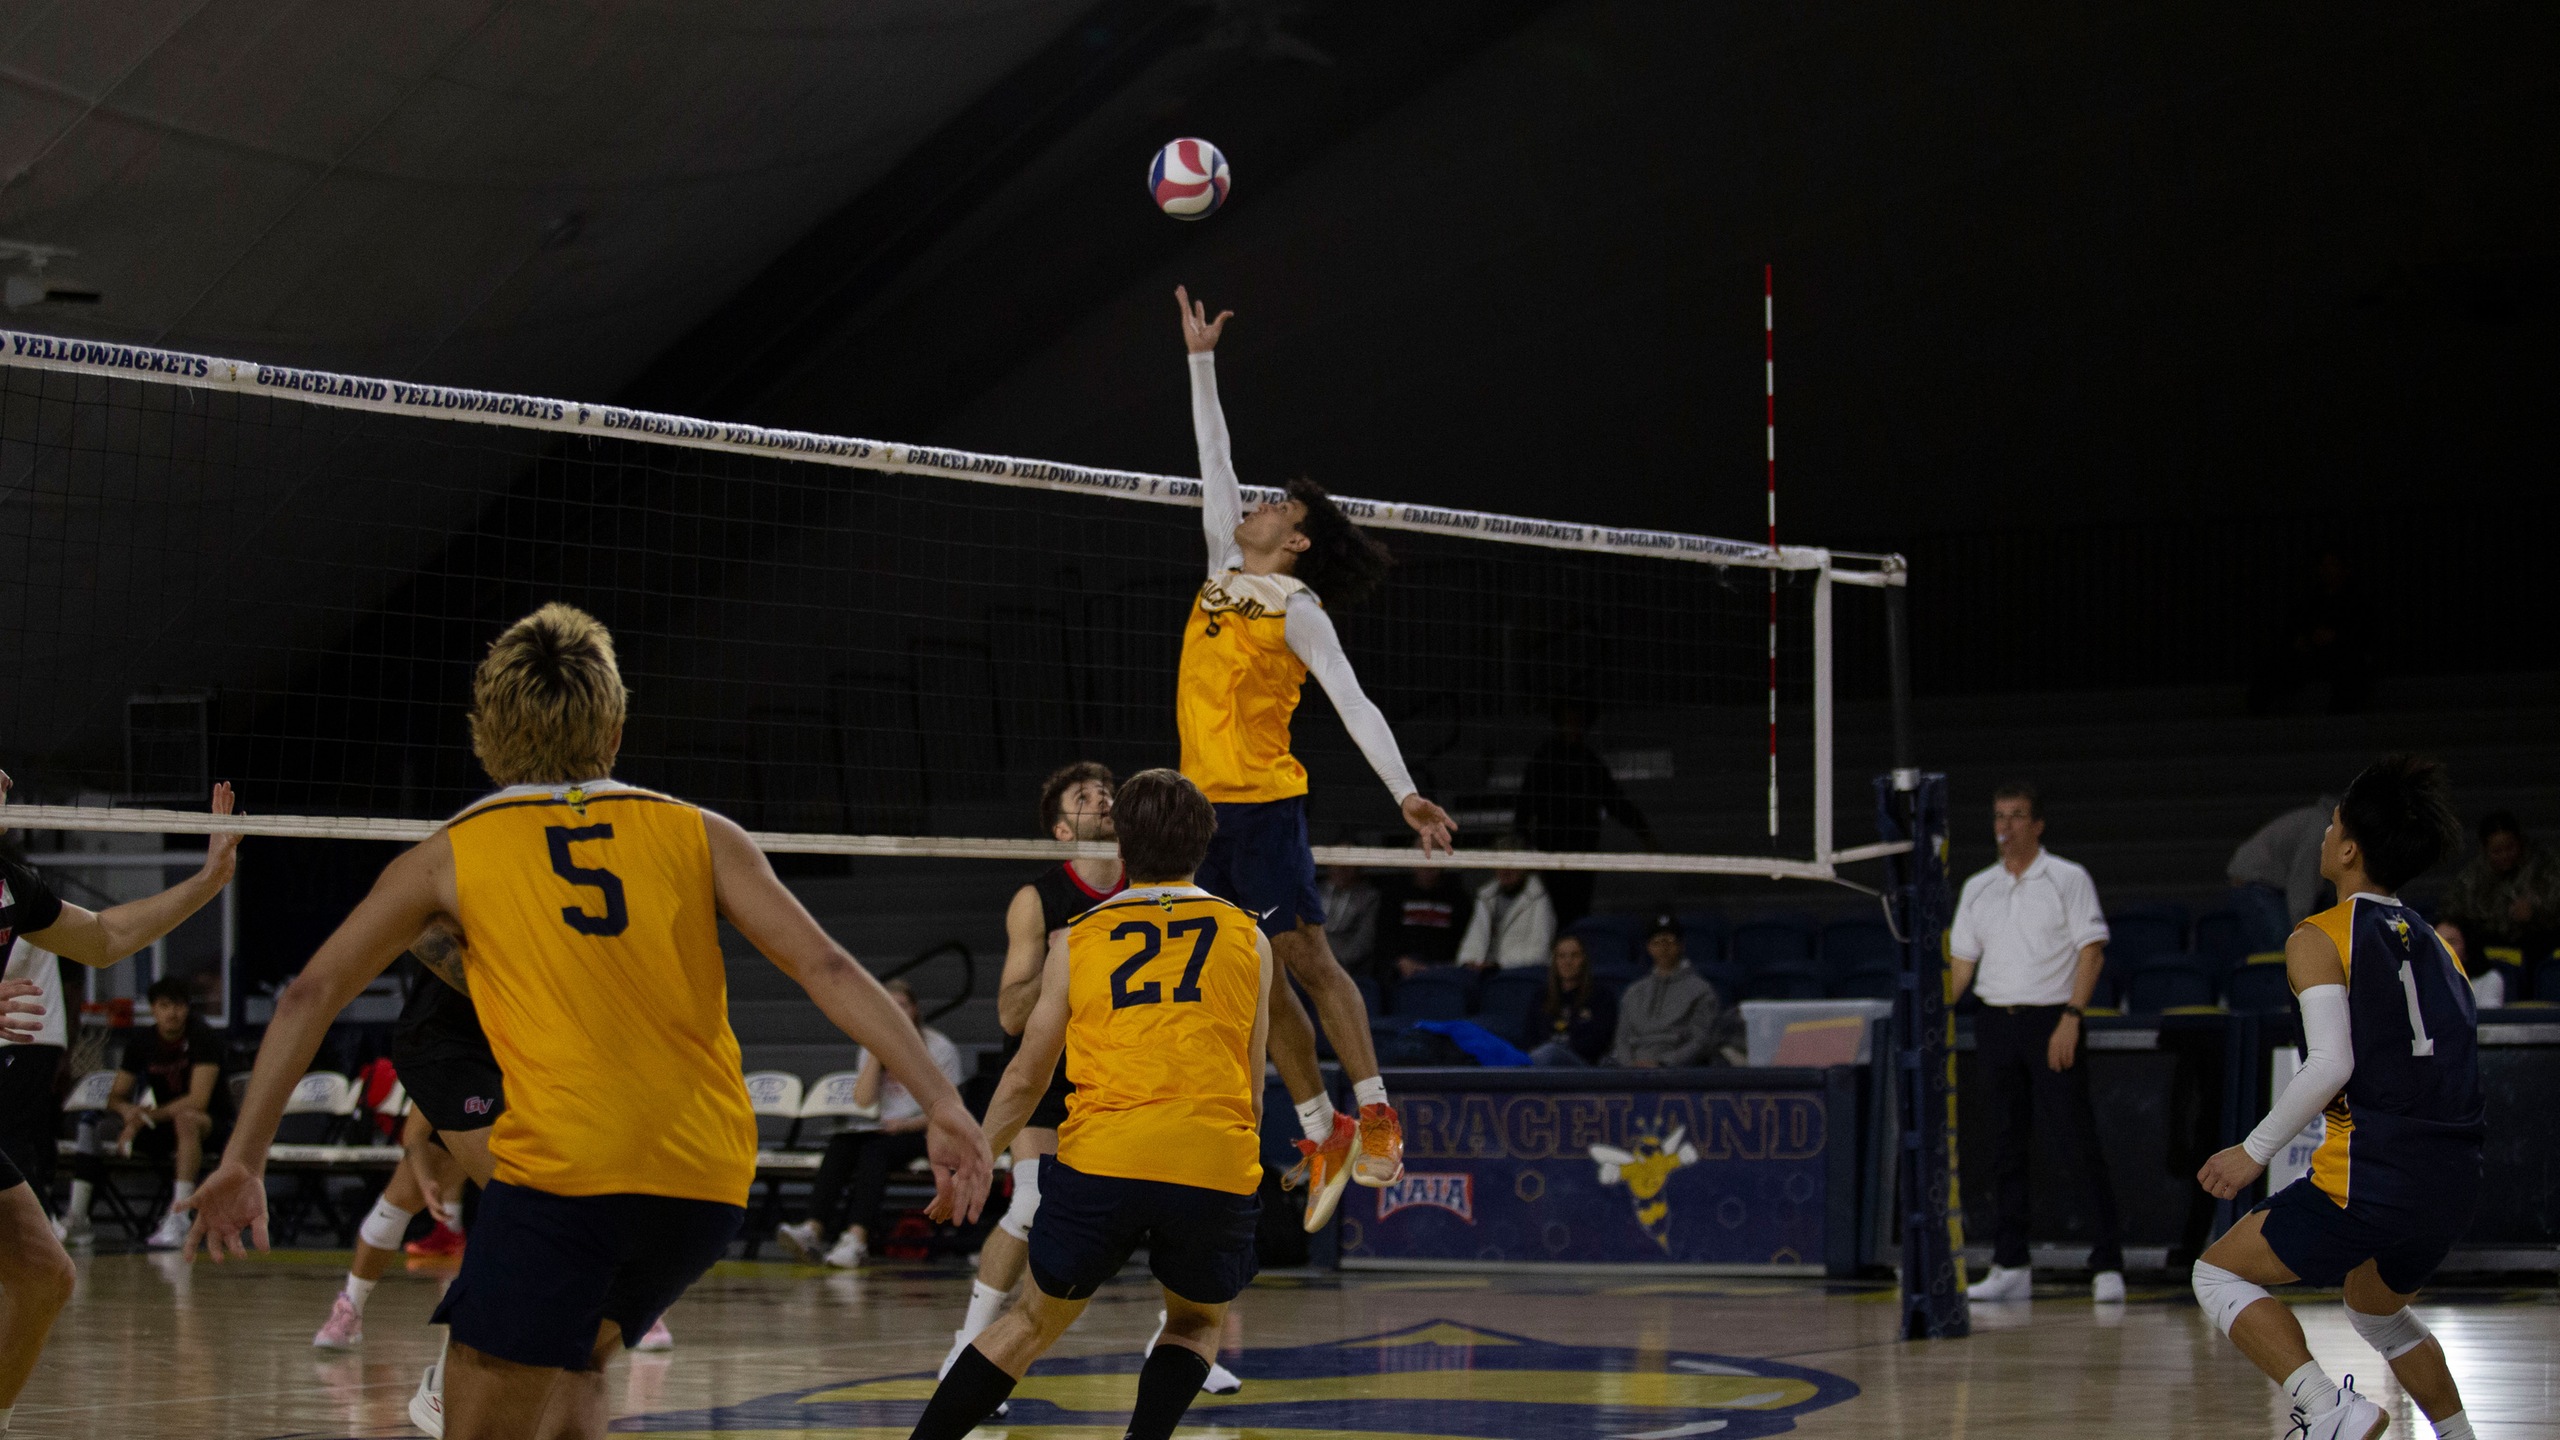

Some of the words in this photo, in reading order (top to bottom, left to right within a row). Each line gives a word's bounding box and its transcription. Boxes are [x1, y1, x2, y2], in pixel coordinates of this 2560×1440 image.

[14, 335, 208, 378] YELLOWJACKETS
[256, 366, 388, 401] GRACELAND
[393, 384, 564, 421] YELLOWJACKETS
[604, 409, 720, 440] GRACELAND
[723, 428, 873, 459] YELLOWJACKETS
[907, 449, 1007, 475] GRACELAND
[1011, 462, 1140, 491] YELLOWJACKETS
[1403, 507, 1480, 530] GRACELAND
[1483, 518, 1583, 542] YELLOWJACKETS
[545, 823, 629, 937] 5
[1110, 916, 1218, 1010] 27
[2398, 960, 2434, 1057] 1
[464, 1095, 494, 1115] GV
[1388, 1093, 1827, 1160] RACELAND
[1384, 1178, 1466, 1211] NAIA
